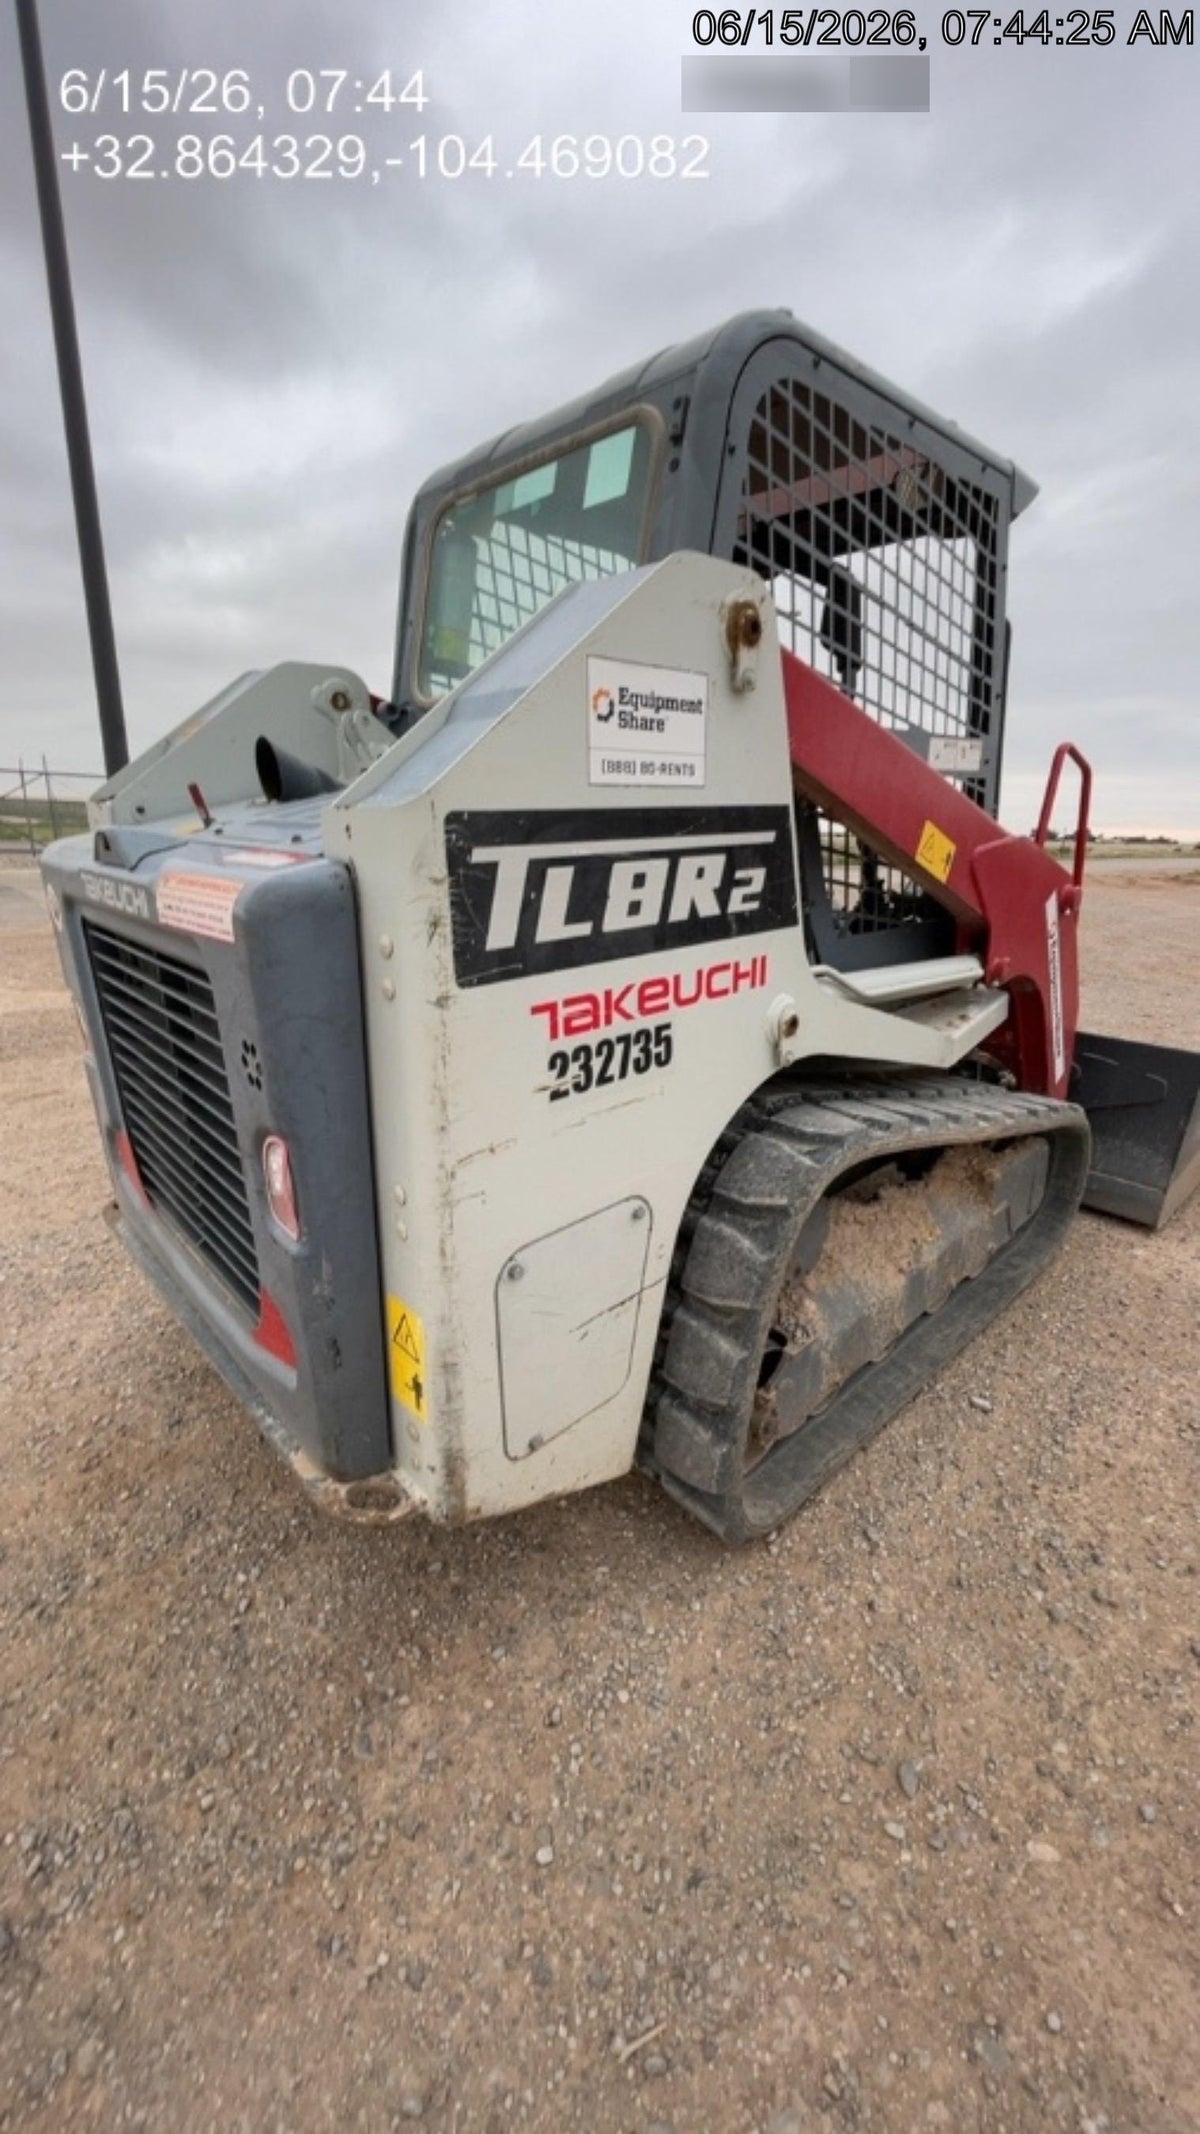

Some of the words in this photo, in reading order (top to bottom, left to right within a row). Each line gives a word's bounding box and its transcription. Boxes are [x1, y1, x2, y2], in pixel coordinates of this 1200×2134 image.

[618, 687, 703, 715] Equipment
[618, 711, 665, 733] Share
[547, 1023, 673, 1103] 232735
